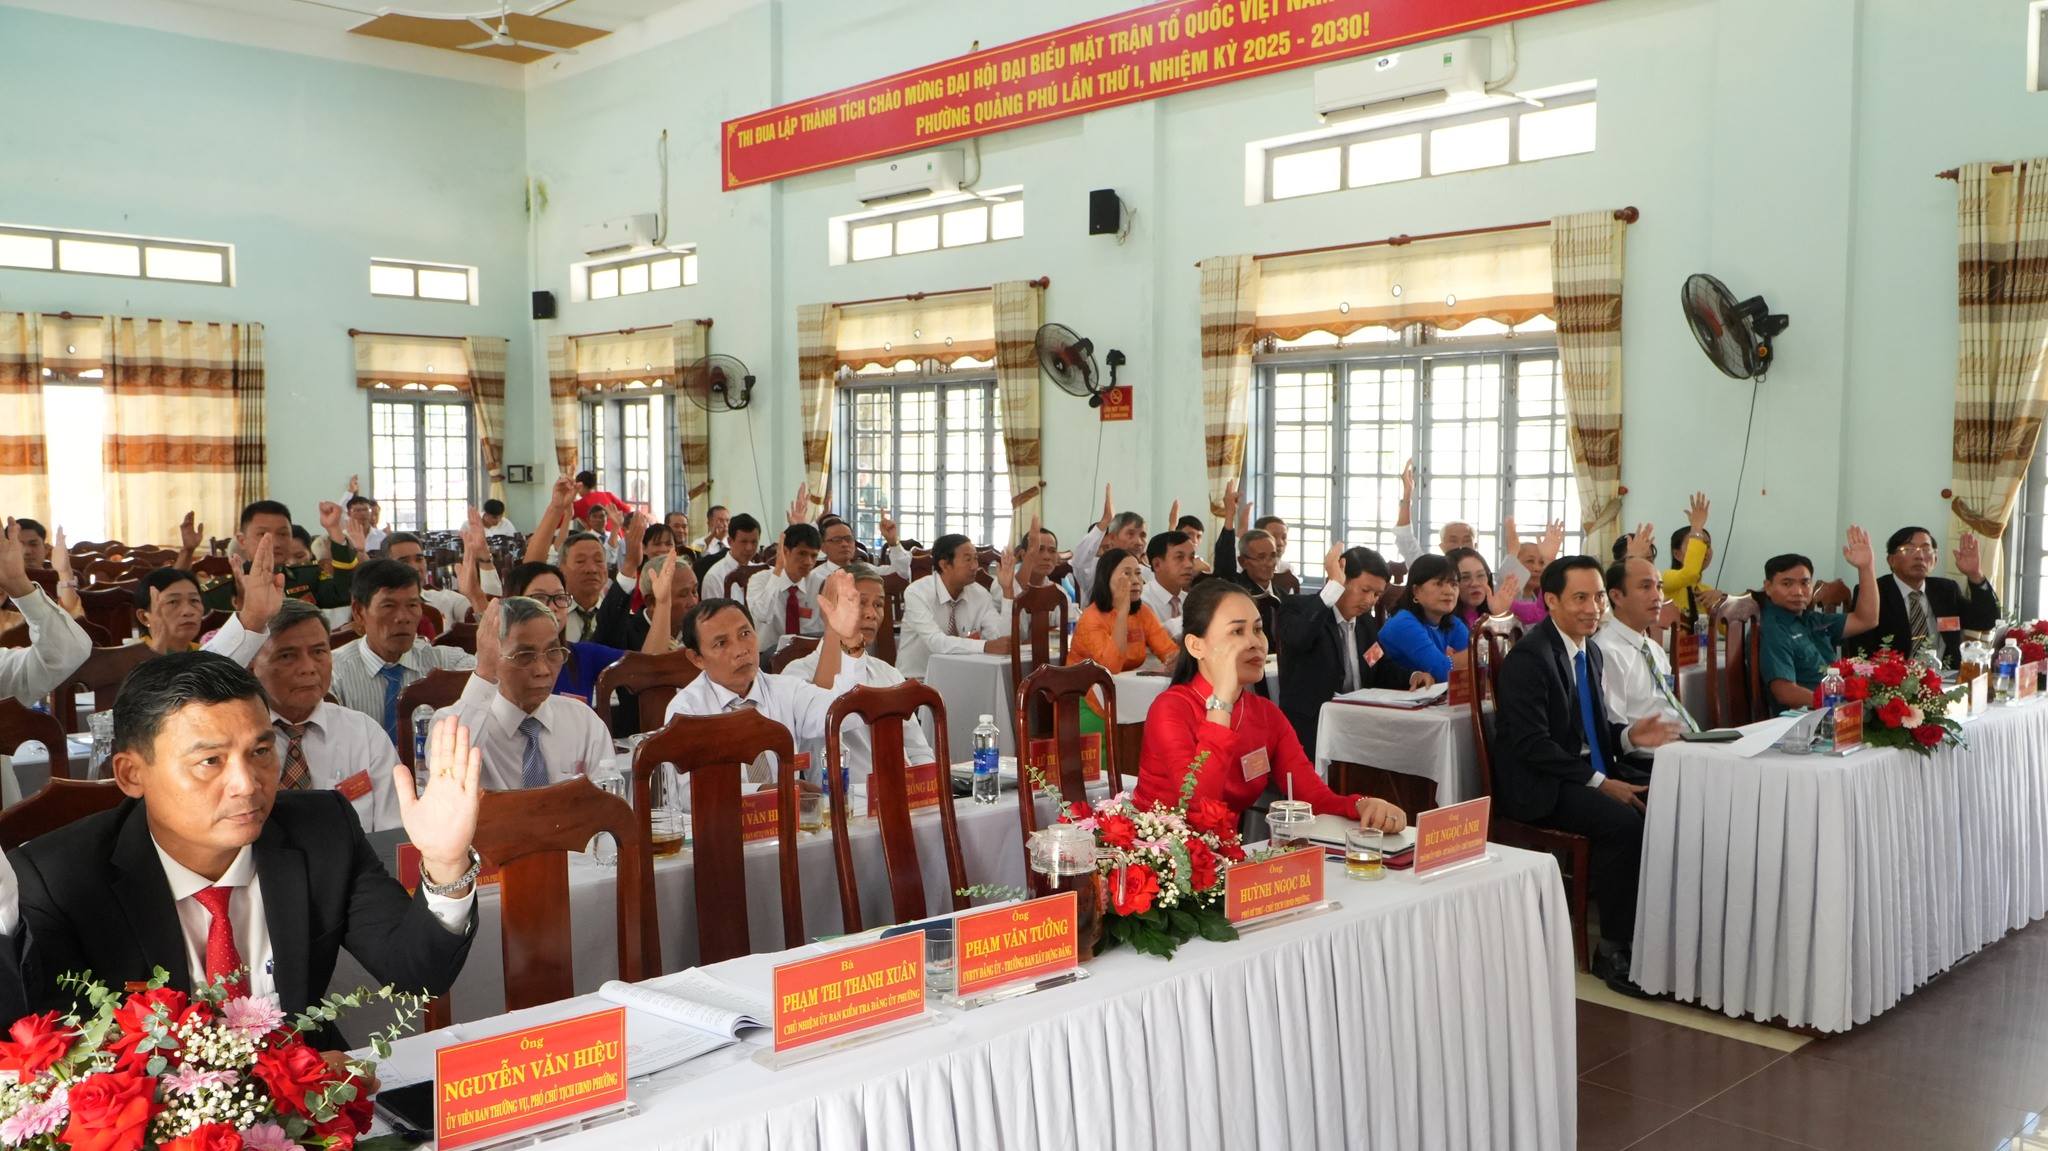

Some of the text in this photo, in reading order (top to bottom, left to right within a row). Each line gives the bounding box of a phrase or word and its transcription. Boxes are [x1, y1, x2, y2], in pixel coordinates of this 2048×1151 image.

[737, 129, 753, 149] THI
[755, 122, 776, 145] ĐUA
[778, 115, 798, 141] LẬP
[800, 107, 837, 133] THÀNH
[840, 99, 866, 123] TÍCH
[869, 88, 901, 115] CHÀO
[904, 79, 944, 107] MỪNG
[947, 72, 970, 98] ĐẠI
[973, 62, 998, 91] HỘI
[1001, 57, 1026, 84] ĐẠI
[1030, 40, 1066, 75] BIỂU
[1069, 35, 1105, 66] MẶT
[1109, 23, 1154, 55] TRẬN
[1158, 8, 1182, 43] TỔ
[1185, 0, 1234, 38] QUỐC
[915, 104, 971, 137] PHƯỜNG
[974, 91, 1024, 125] QUẢNG
[1027, 80, 1059, 112] PHÚ
[1062, 71, 1094, 103] LẦN
[1097, 63, 1130, 96] THỨ
[1132, 65, 1145, 89] I,
[1150, 48, 1210, 83] NHIỆM
[1213, 38, 1239, 70] KỲ
[1243, 30, 1292, 64] 2025
[1310, 11, 1371, 49] 2030!
[1240, 882, 1273, 904] HUỲNH
[1274, 875, 1298, 896] NGỌC
[965, 916, 1069, 959] PHẠM VĂN TƯỜNG
[1012, 909, 1030, 922] Ông
[783, 959, 917, 1014] PHẠM THỊ THANH XUÂN
[841, 959, 855, 972] Bà
[784, 988, 921, 1036] CHỦ NHIỆM ỦY BAN KIỂM TRA ĐẢNG ỦY PHƯỜNG
[520, 1036, 545, 1050] Ông
[443, 1039, 619, 1103] NGUYỄN VĂN HIỆU
[446, 1071, 618, 1130] ỦY VIÊN BAN THƯỜNG VỤ, PHÓ CHỦ TỊCH UBND PHƯỜNG
